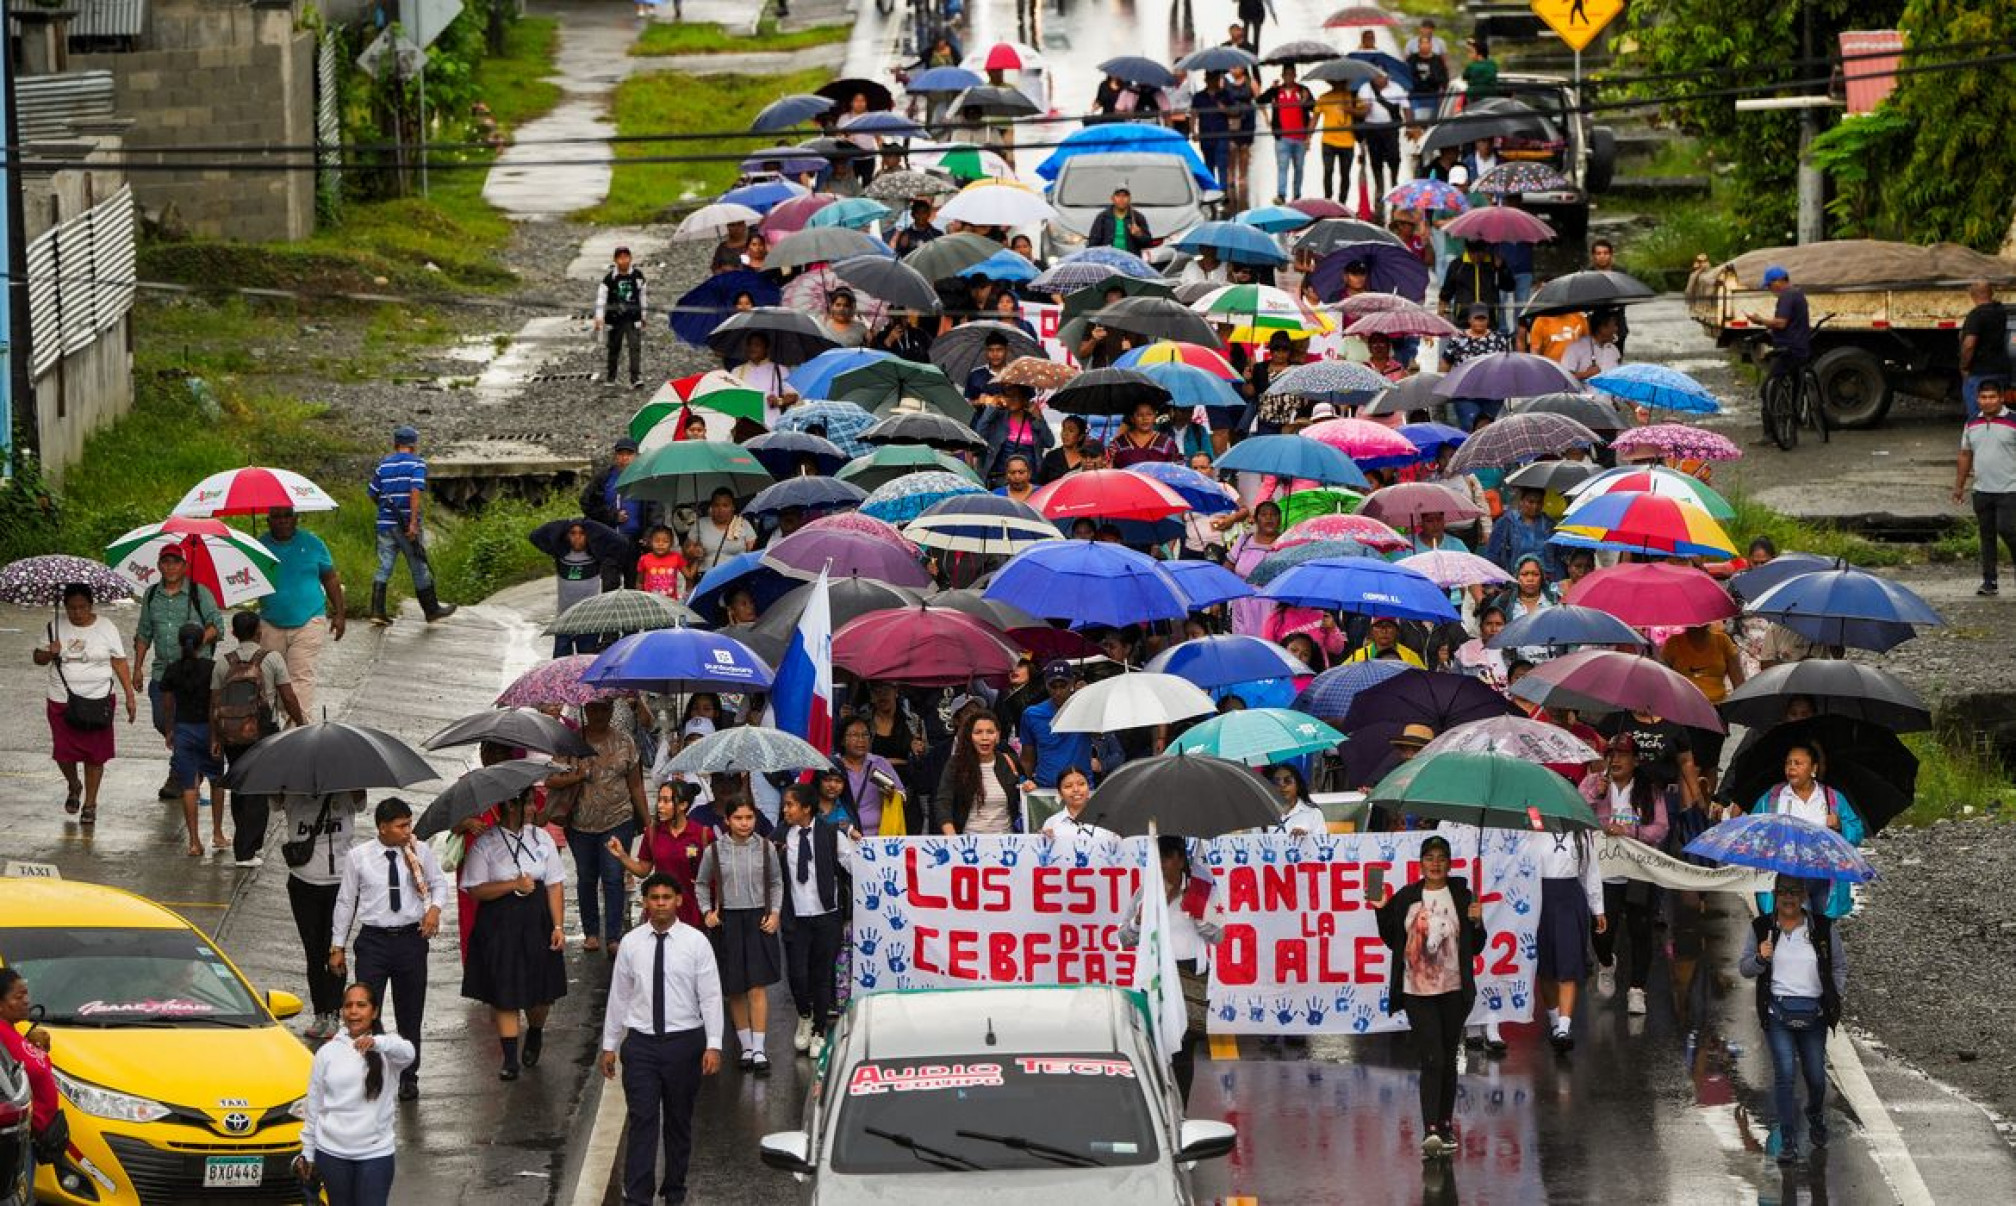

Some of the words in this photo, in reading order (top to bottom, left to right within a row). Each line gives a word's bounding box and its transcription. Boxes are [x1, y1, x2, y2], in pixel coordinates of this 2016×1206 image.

[18, 864, 50, 876] TAXI
[905, 846, 1011, 911] LOS
[1301, 911, 1335, 938] LA
[851, 1062, 1003, 1086] AUDIO
